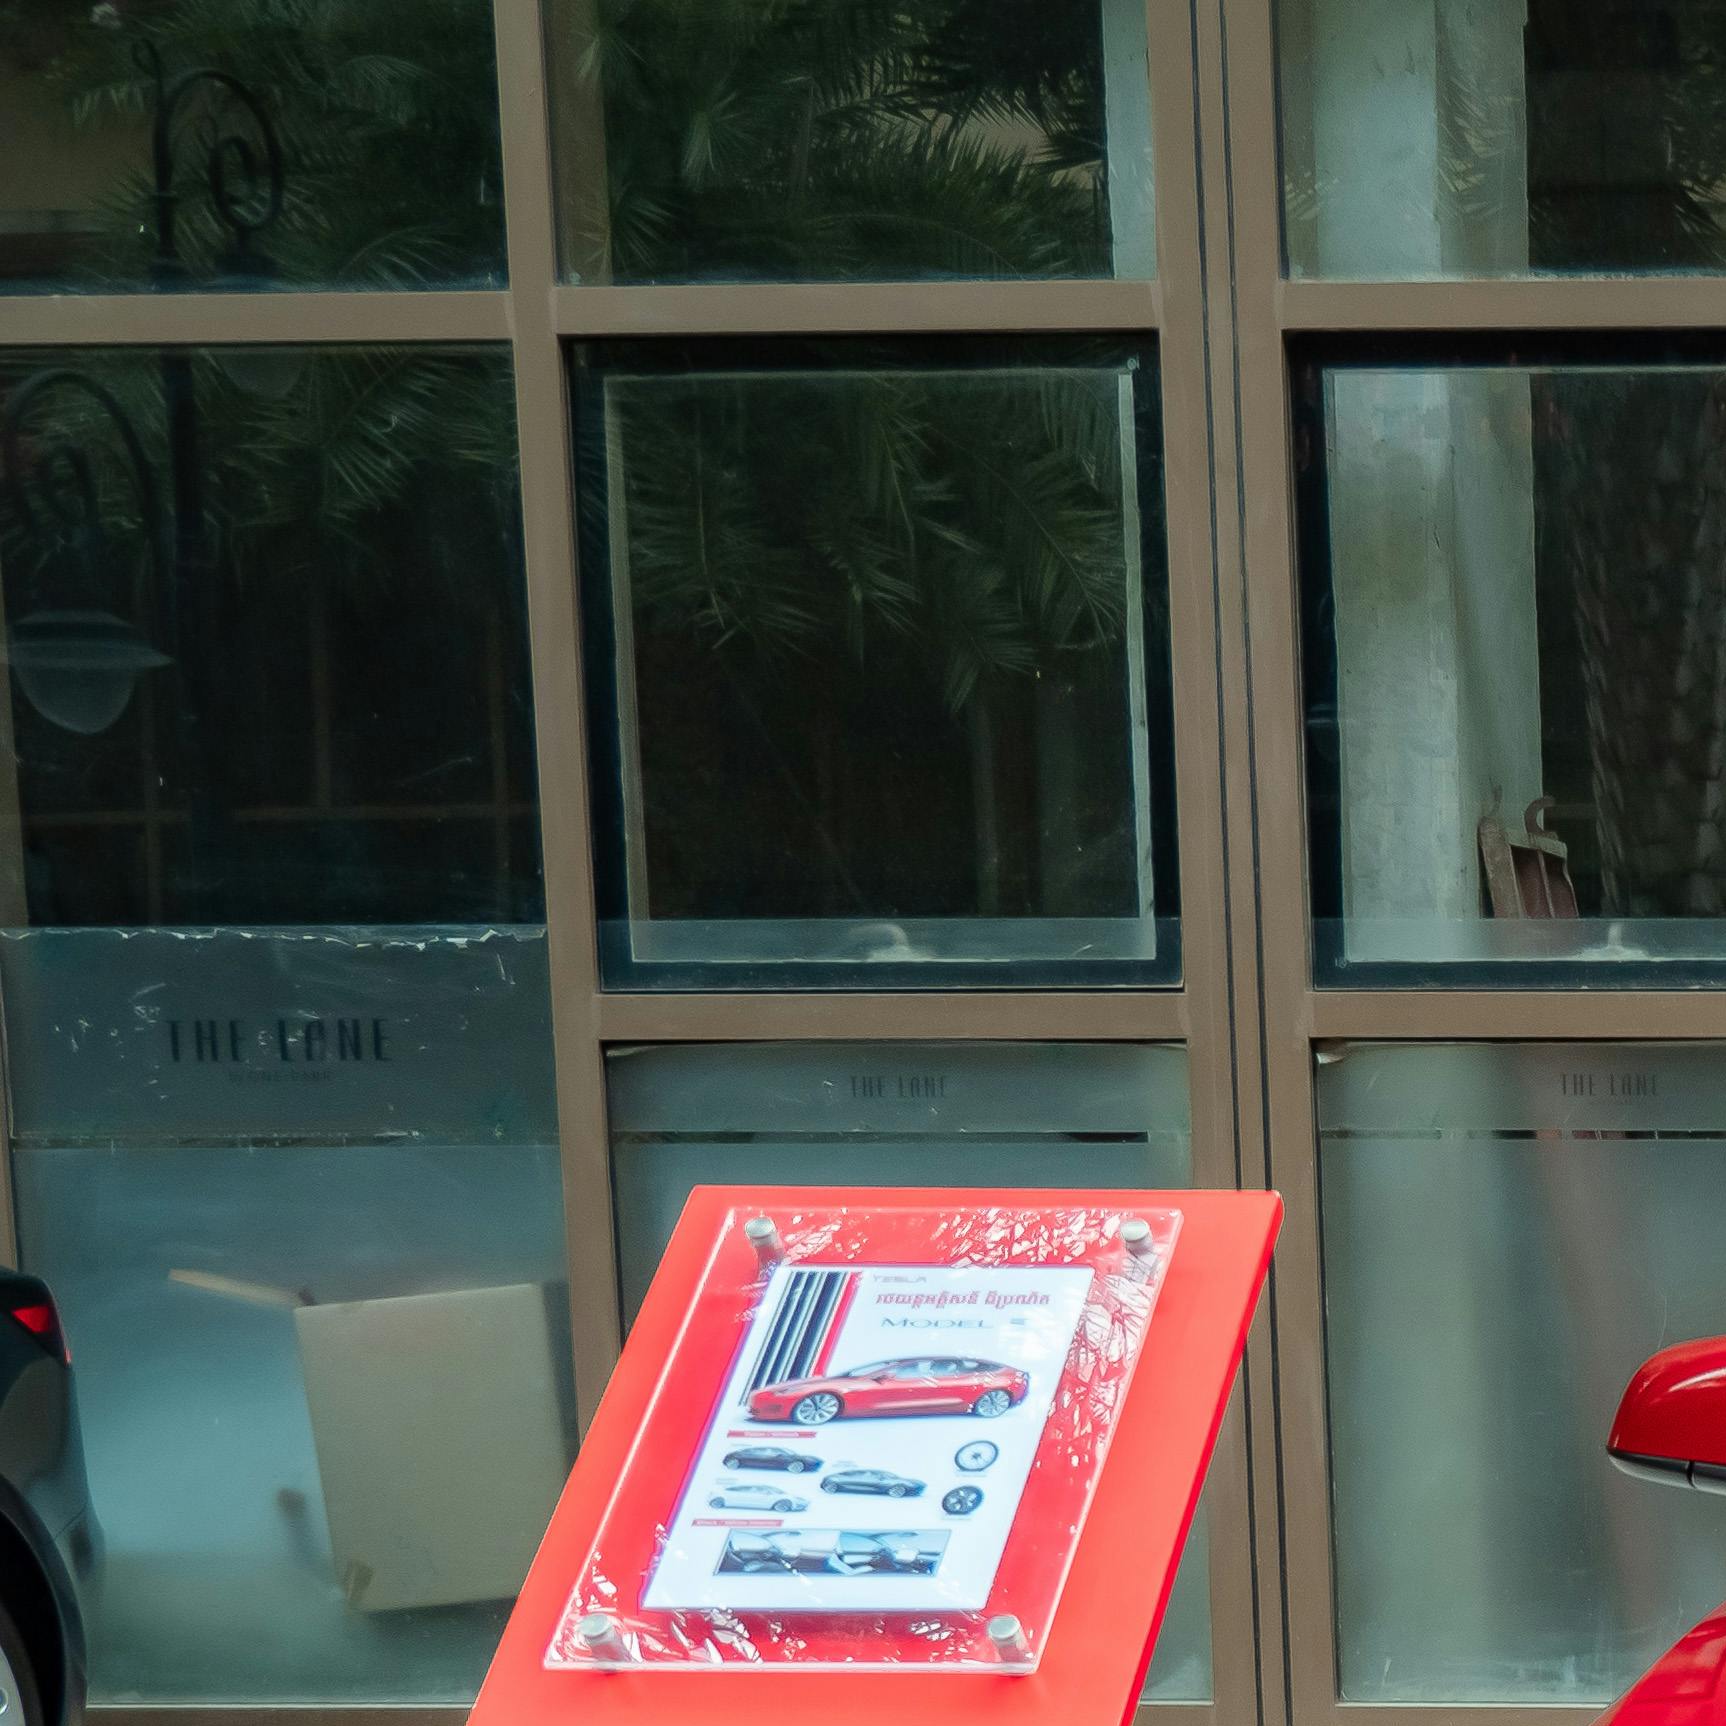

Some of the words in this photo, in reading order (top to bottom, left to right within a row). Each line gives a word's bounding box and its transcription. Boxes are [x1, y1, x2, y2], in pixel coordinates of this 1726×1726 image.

[166, 1018, 245, 1062] THE
[851, 1075, 885, 1097] THE
[898, 1075, 946, 1097] LANE
[1560, 1073, 1596, 1096] THE
[1610, 1073, 1659, 1096] LANE
